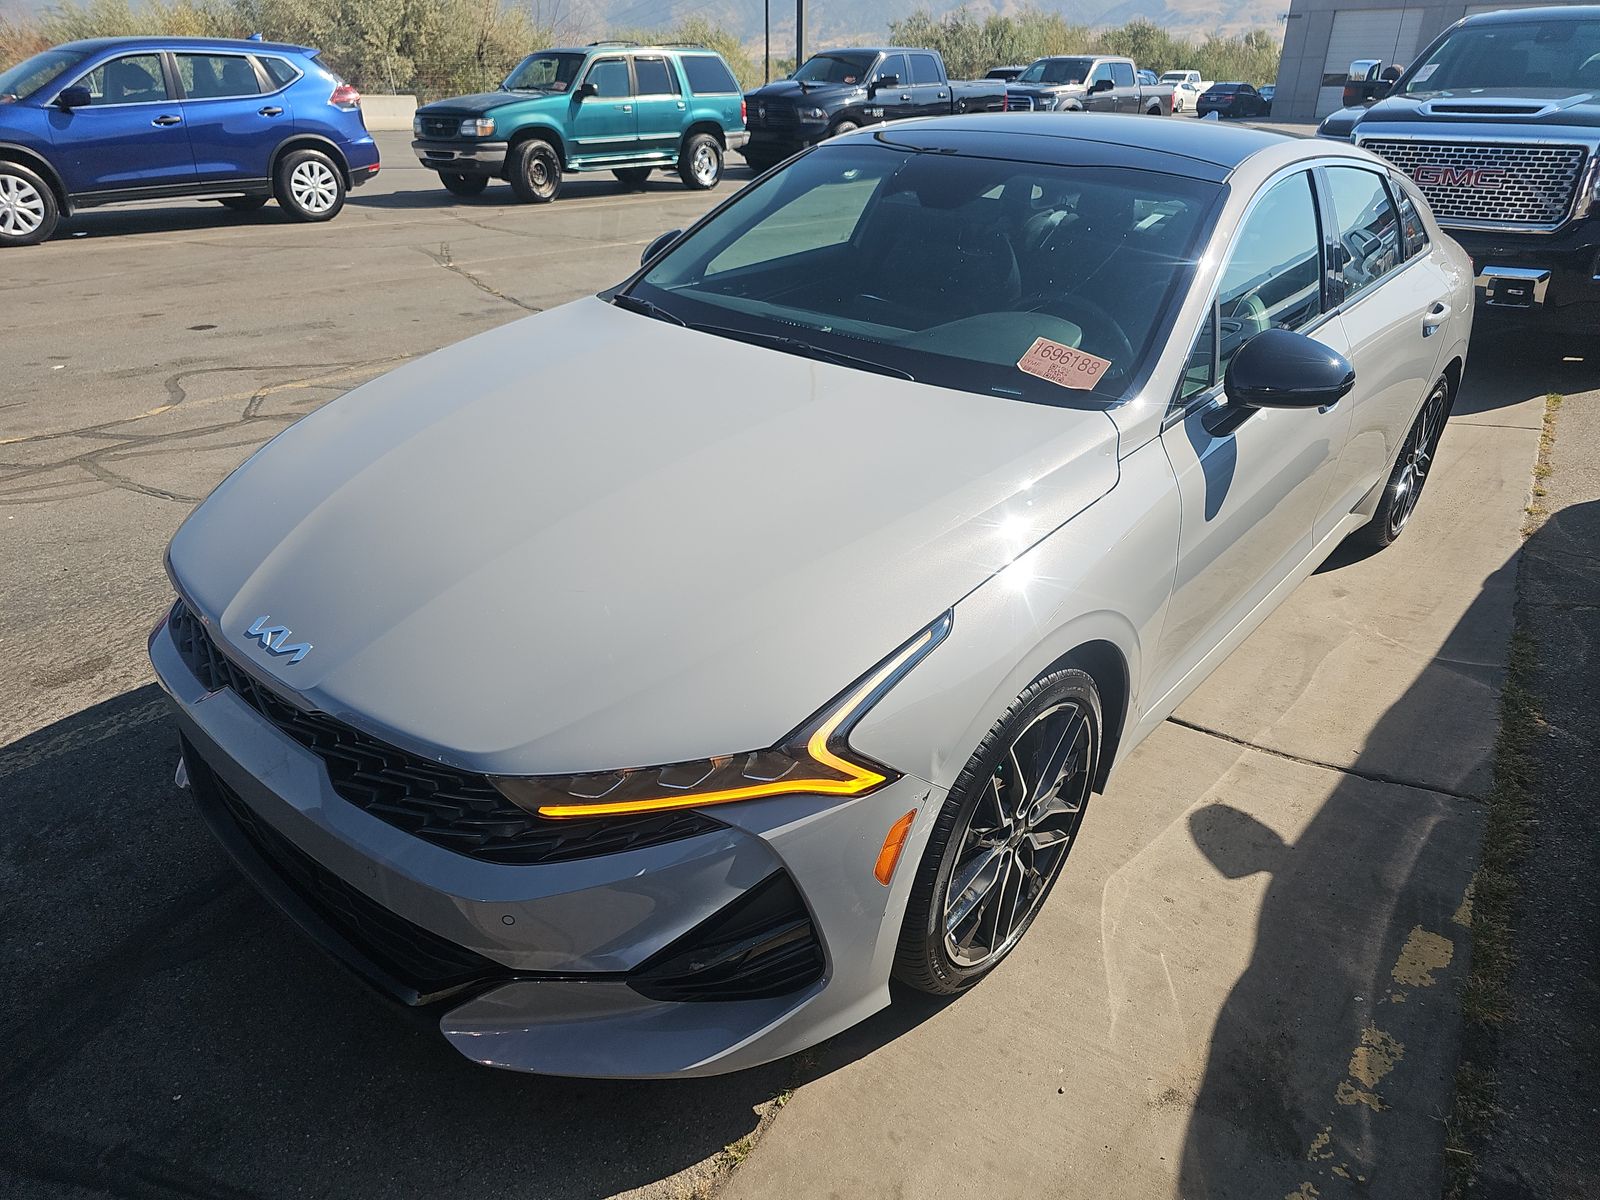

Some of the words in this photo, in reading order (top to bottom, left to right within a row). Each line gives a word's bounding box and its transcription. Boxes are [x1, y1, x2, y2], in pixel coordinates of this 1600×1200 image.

[1414, 165, 1505, 189] GMC
[1034, 342, 1101, 375] 1696188
[245, 615, 313, 663] KIA
